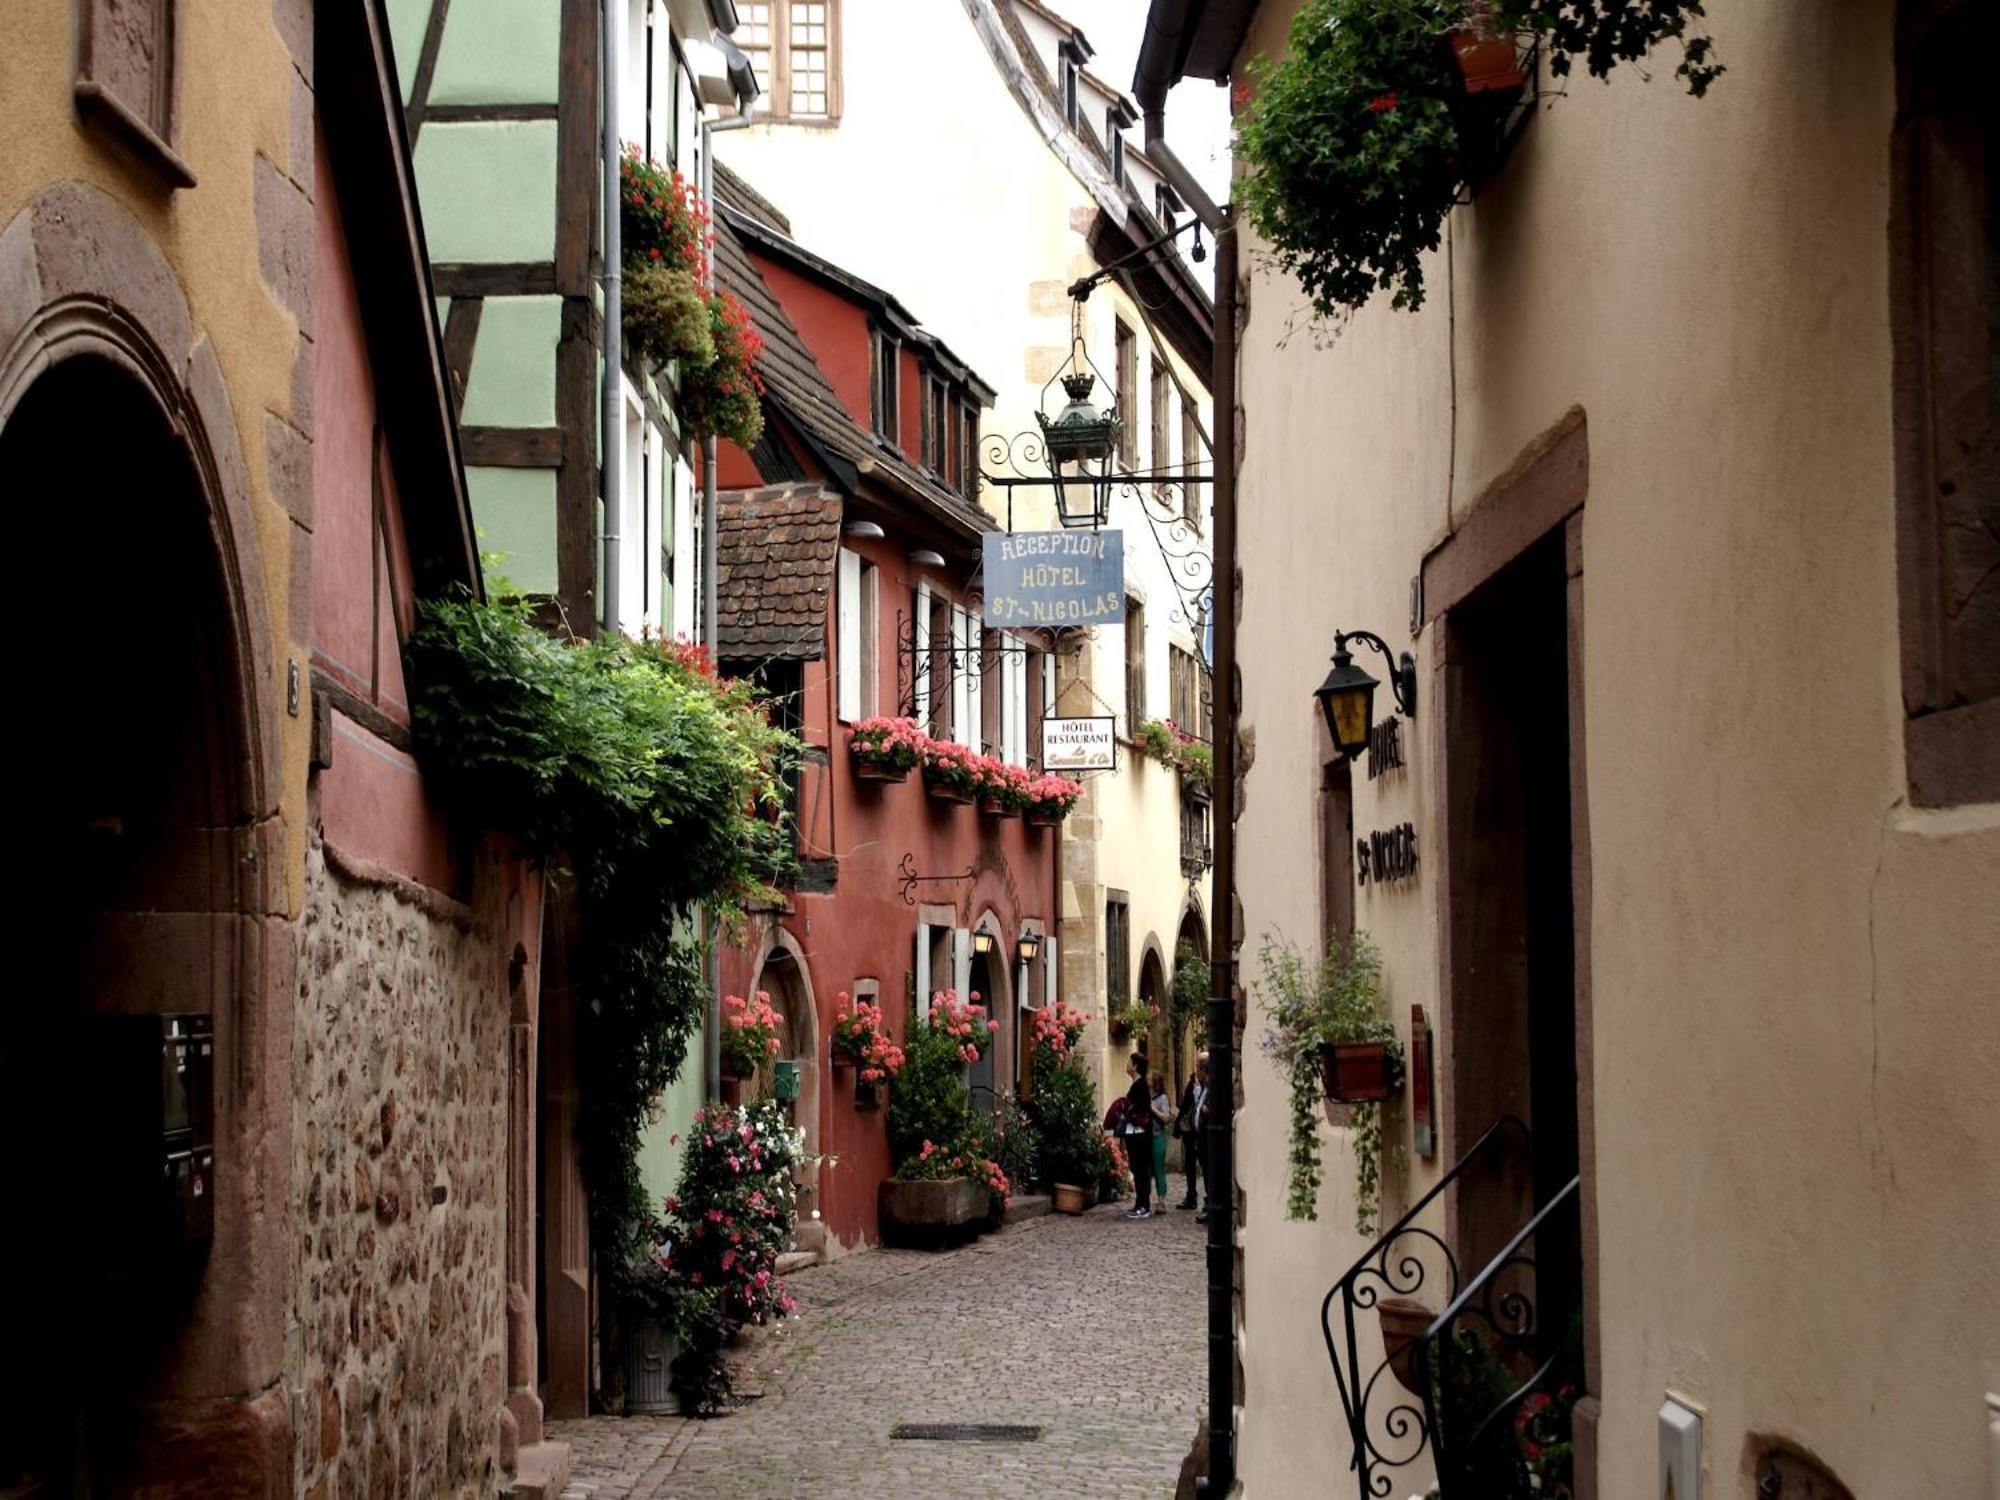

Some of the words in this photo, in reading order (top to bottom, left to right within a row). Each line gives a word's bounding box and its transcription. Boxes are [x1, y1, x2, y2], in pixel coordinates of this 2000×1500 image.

[1002, 533, 1104, 560] RÉCEPTION
[1022, 563, 1087, 588] HÔTEL
[1062, 721, 1093, 733] HÔTEL
[1047, 734, 1109, 744] RESTAURANT
